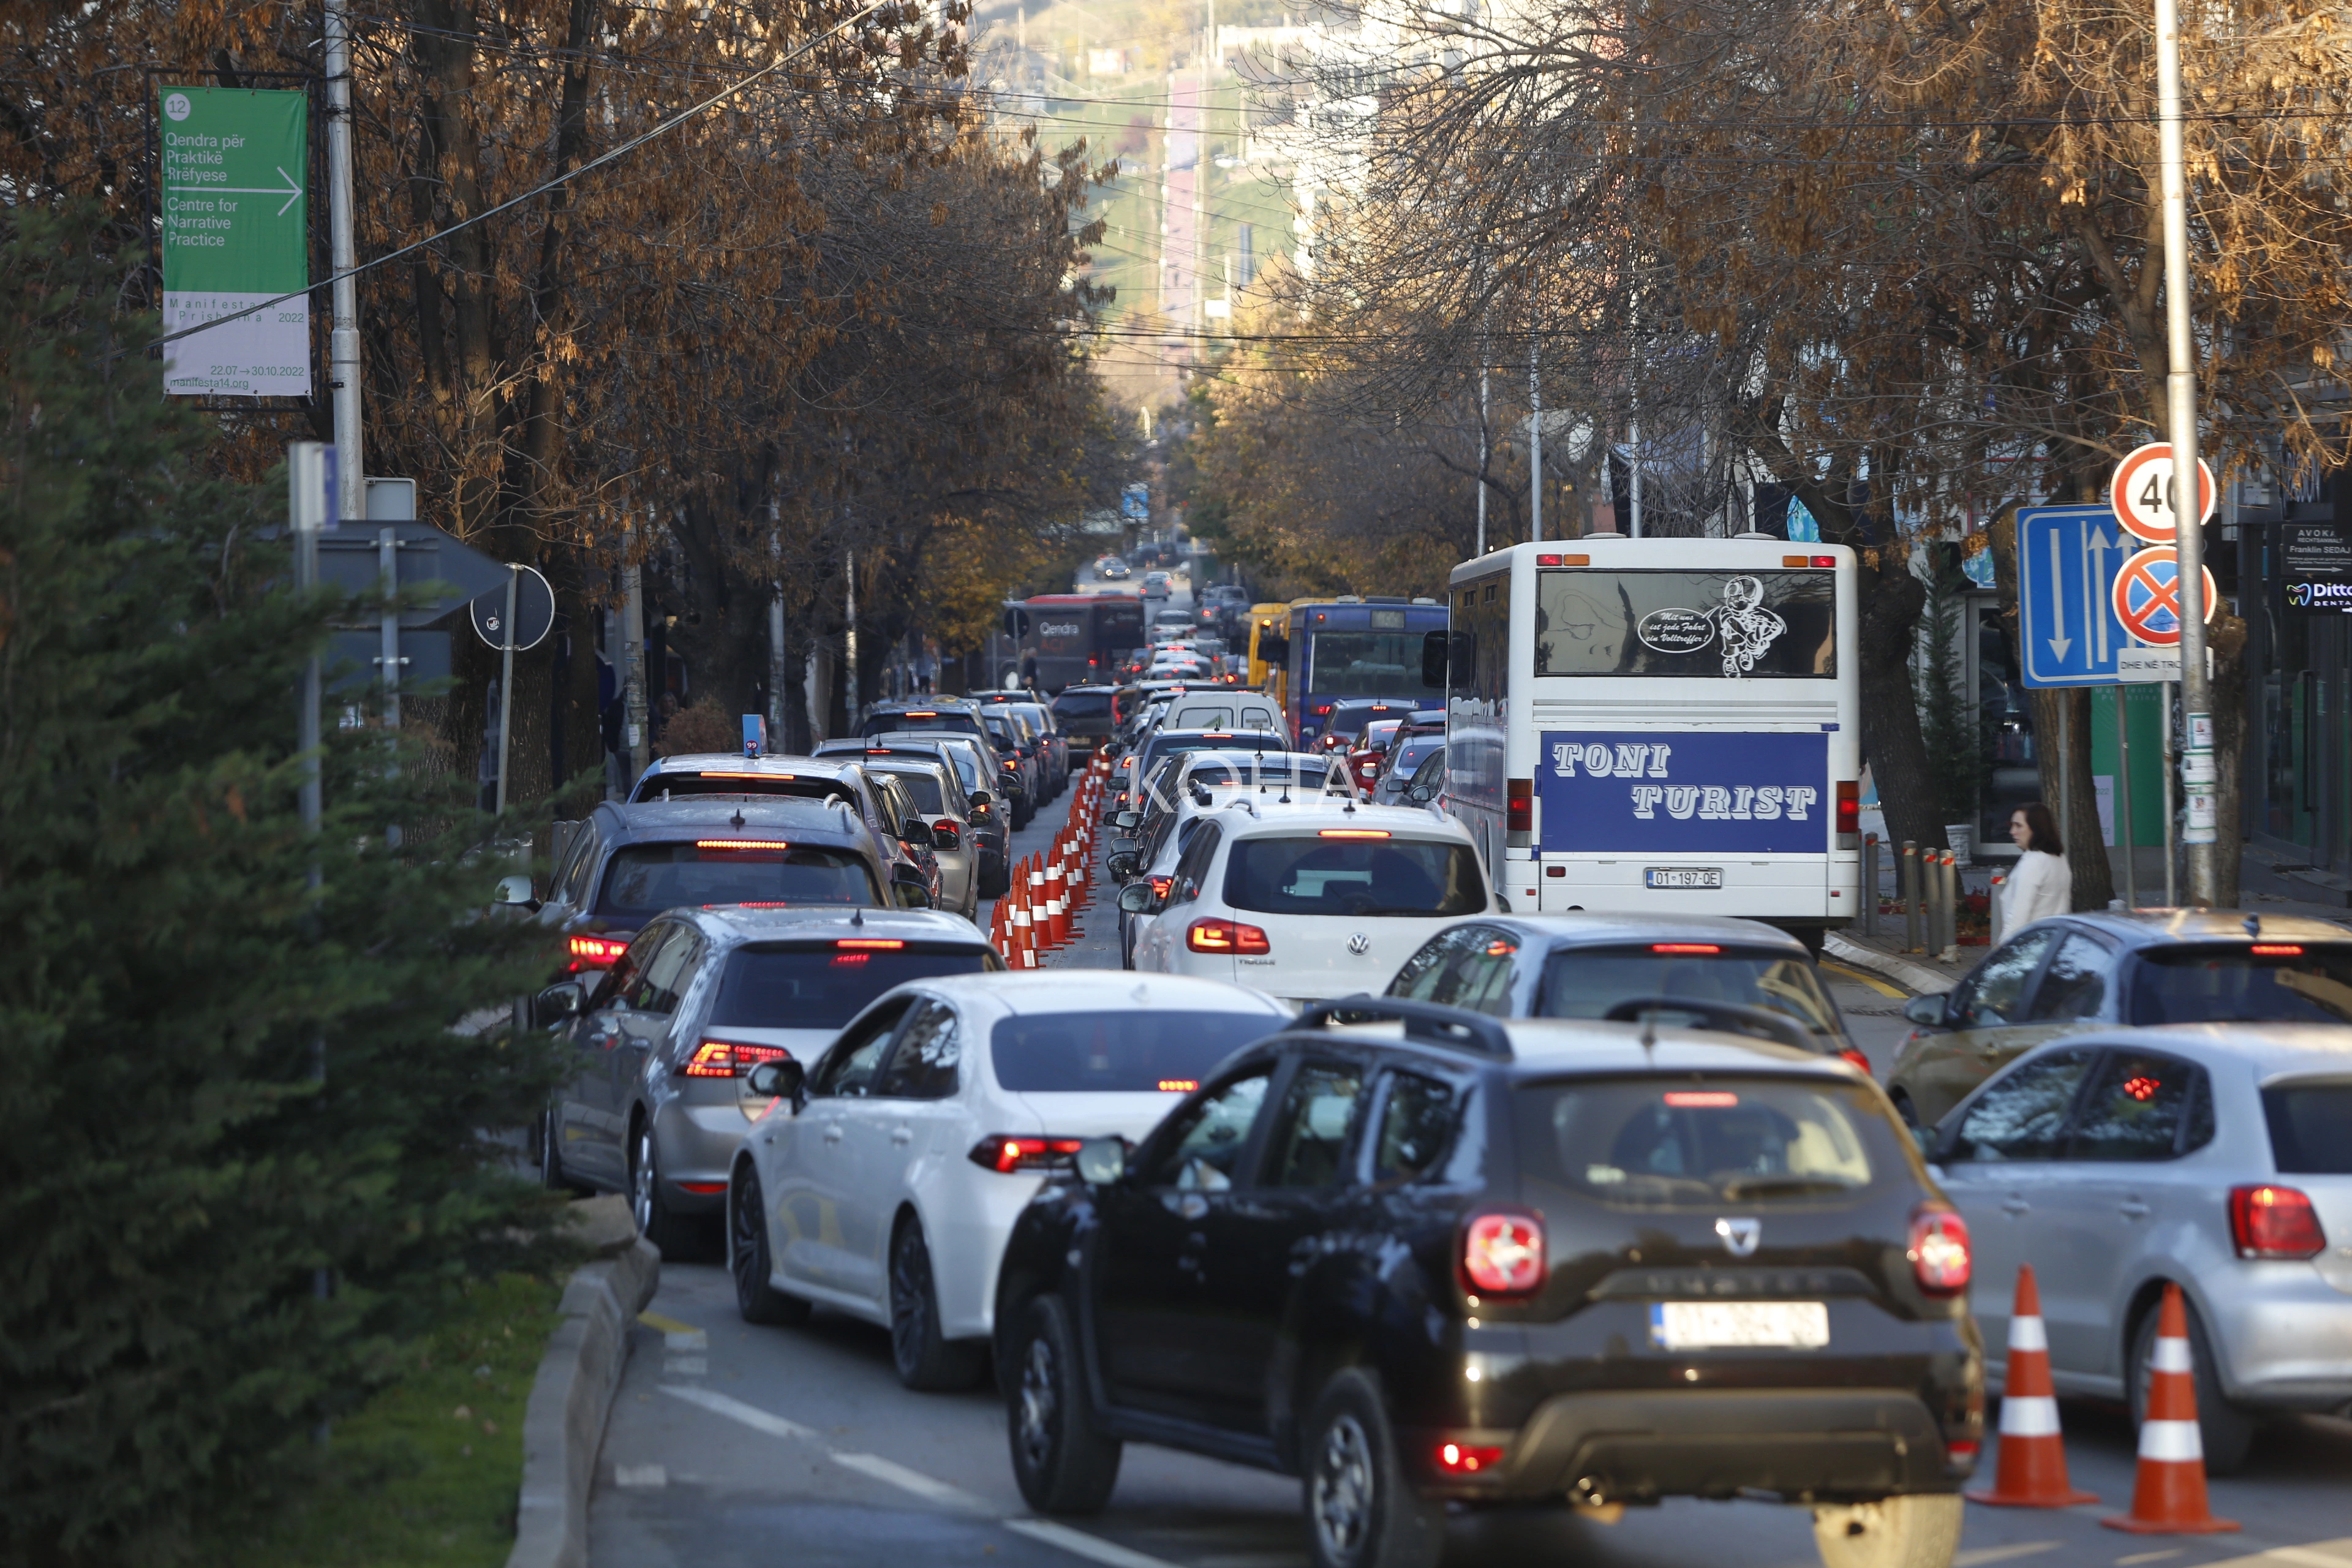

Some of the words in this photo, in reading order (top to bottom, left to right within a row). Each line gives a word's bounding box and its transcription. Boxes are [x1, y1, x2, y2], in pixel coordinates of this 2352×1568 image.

[169, 100, 186, 113] 12
[165, 132, 217, 147] Qendra
[222, 134, 245, 150] për
[167, 150, 223, 164] Praktikë
[168, 167, 227, 184] Rrëfyese
[167, 197, 214, 211] Centre
[219, 198, 238, 211] for
[168, 214, 231, 229] Narrative
[169, 232, 225, 246] Practice
[170, 299, 256, 309] Manifesta
[179, 311, 262, 322] Prishina
[279, 313, 304, 322] 2022
[211, 366, 238, 375] 22.07
[252, 367, 304, 376] 30.10.2022
[170, 377, 249, 390] manifesta14.org
[1039, 622, 1079, 637] Qendra
[1662, 624, 1680, 633] jede
[1681, 622, 1706, 632] Fahrt
[2144, 659, 2158, 669] NË
[1552, 742, 1672, 778] TONI
[1630, 785, 1817, 821] TURIST
[1656, 872, 1669, 885] 01
[1679, 872, 1717, 885] 197-QE
